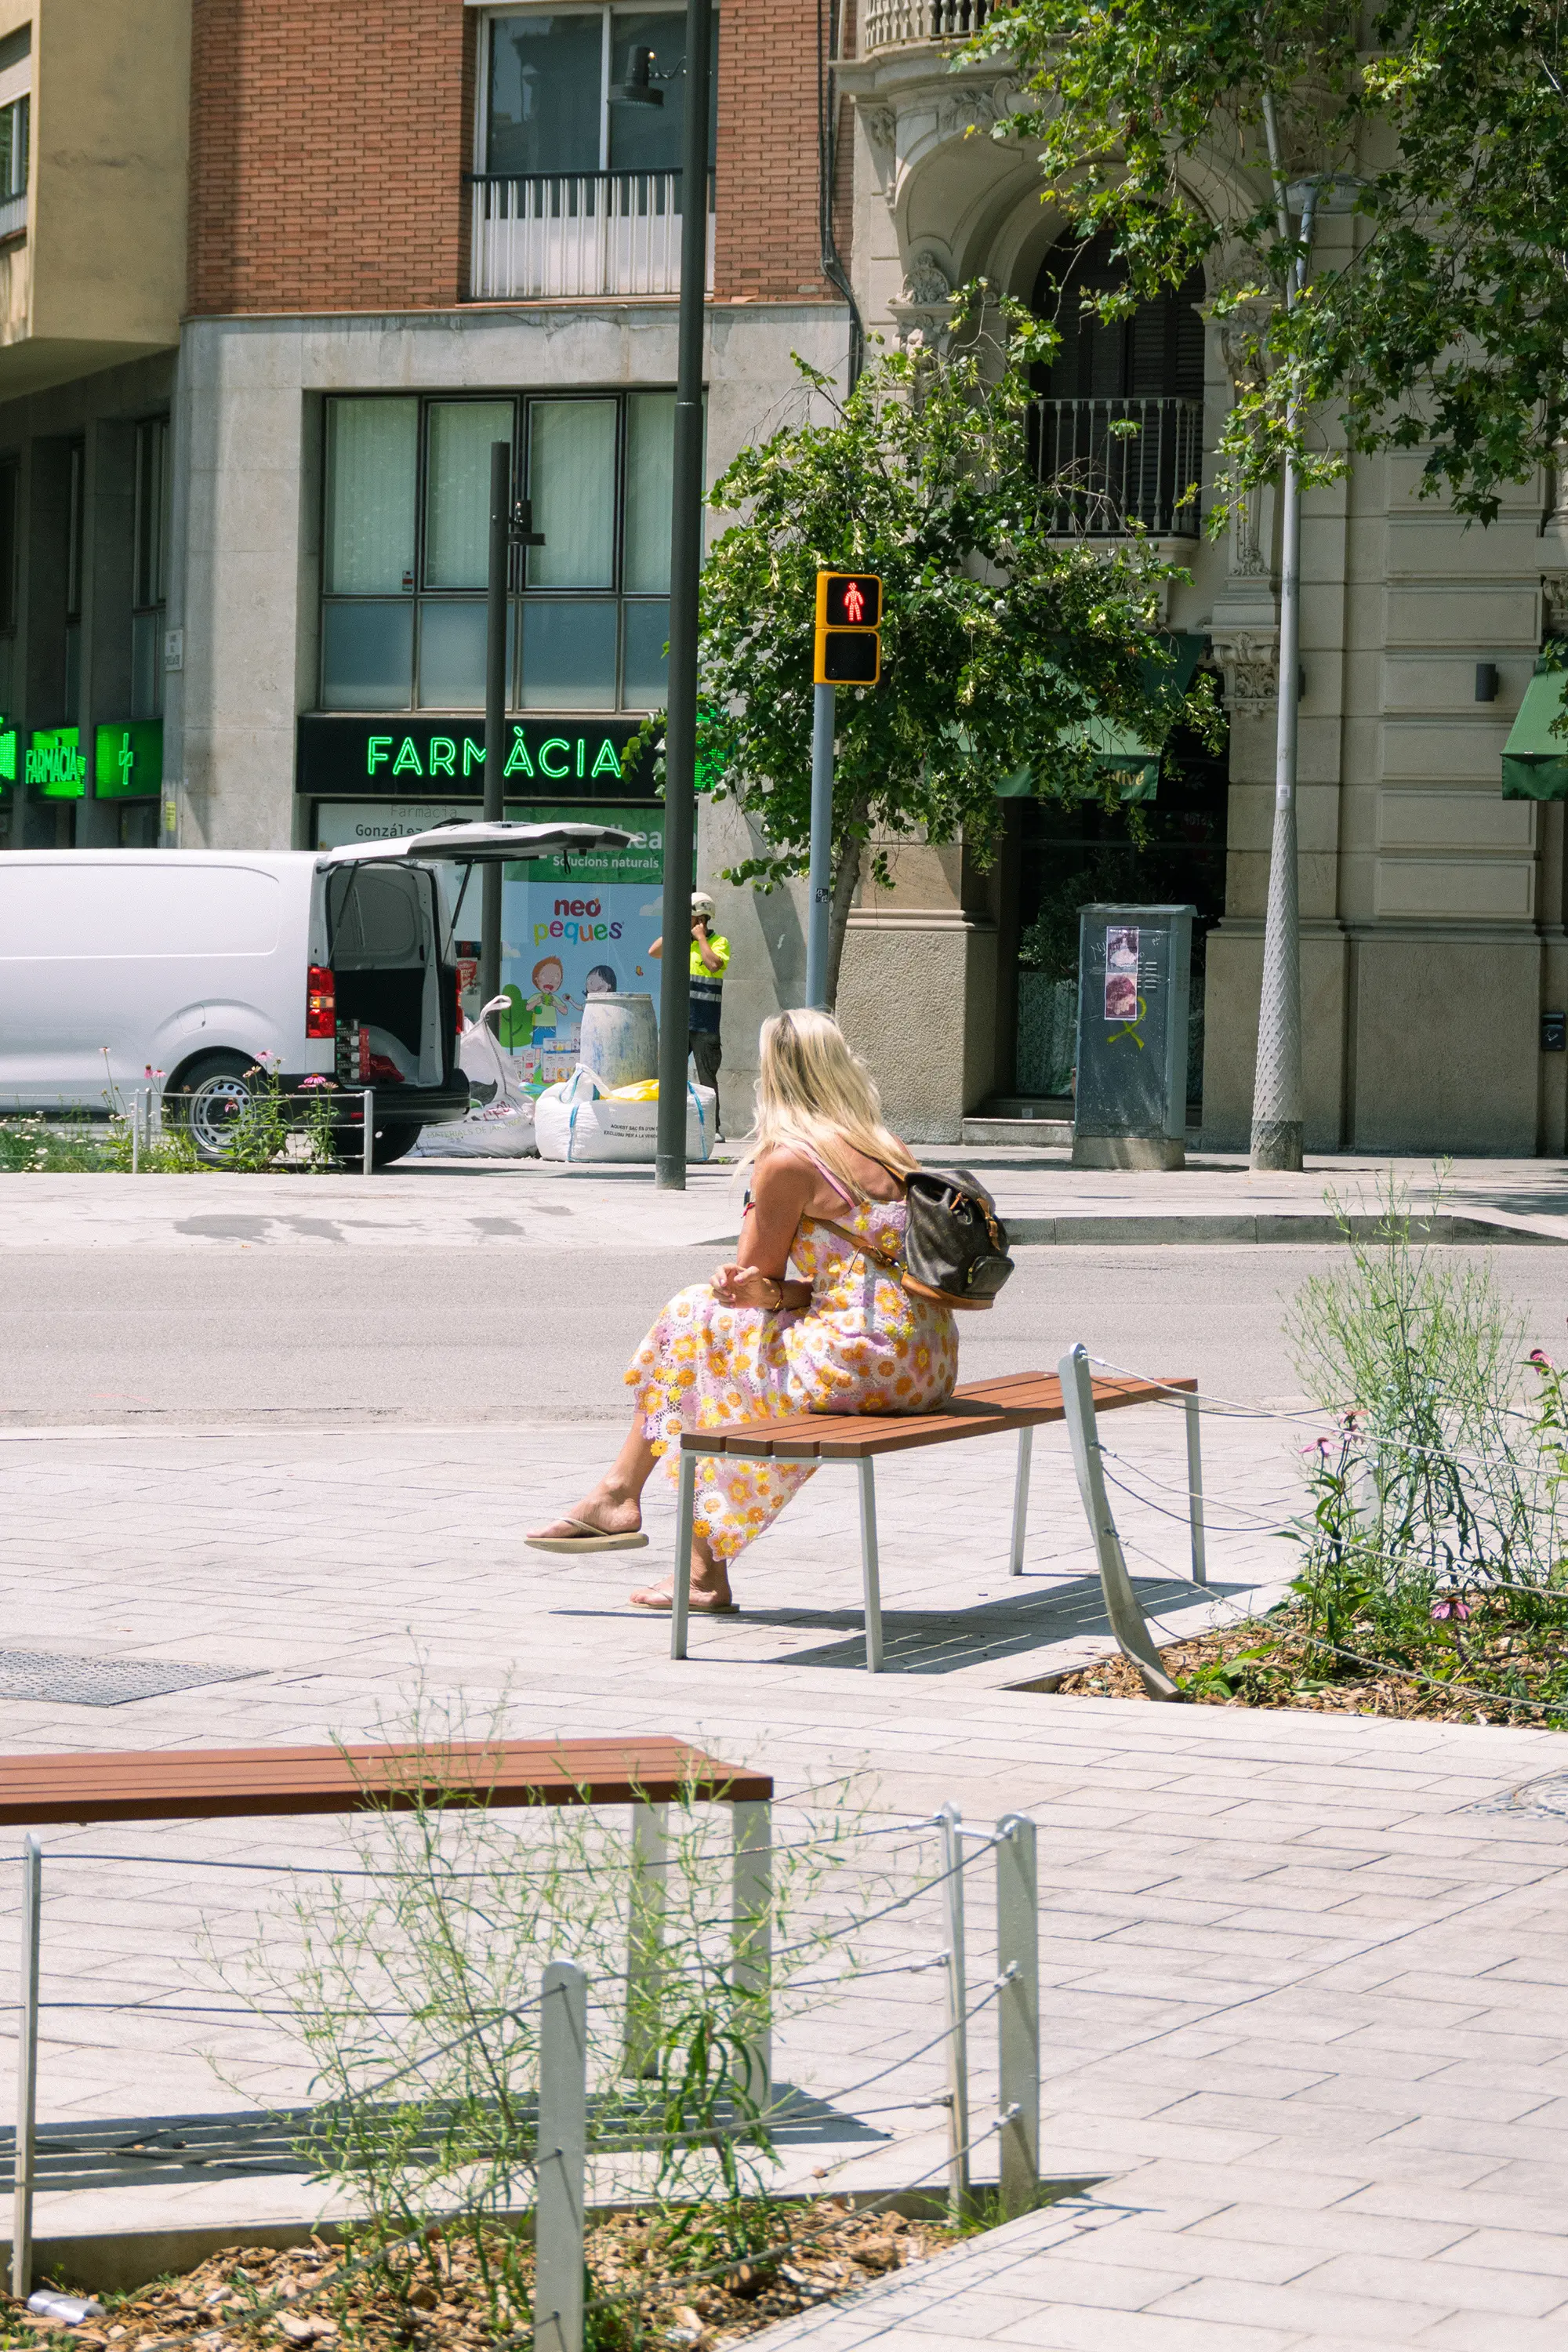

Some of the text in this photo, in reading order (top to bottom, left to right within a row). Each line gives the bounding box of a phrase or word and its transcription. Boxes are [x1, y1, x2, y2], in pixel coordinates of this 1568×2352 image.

[612, 858, 659, 869] naturals
[554, 898, 601, 917] neo
[533, 920, 623, 948] peques
